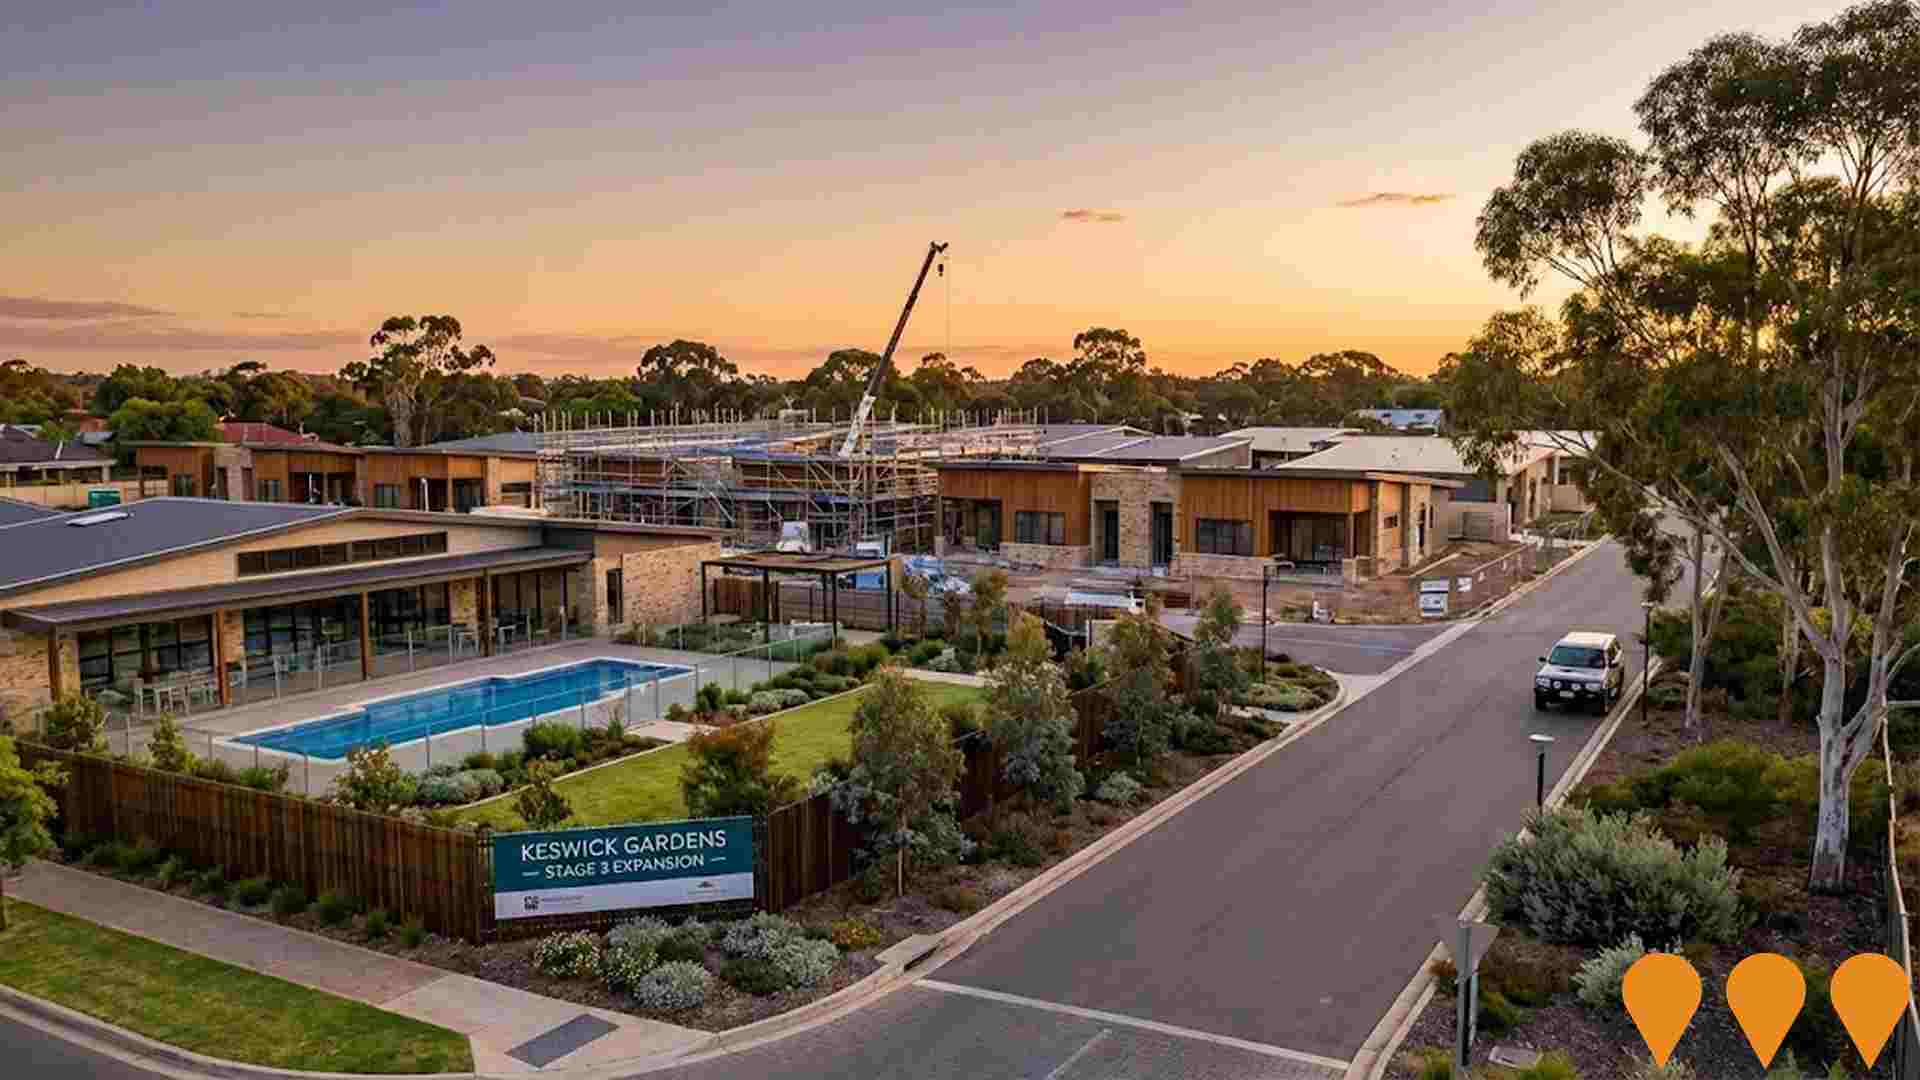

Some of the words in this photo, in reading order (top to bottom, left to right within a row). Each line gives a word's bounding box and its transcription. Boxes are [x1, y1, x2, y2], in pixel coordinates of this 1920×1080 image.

[521, 837, 618, 862] KESWICK
[623, 830, 727, 854] GARDENS
[545, 862, 596, 880] STAGE
[600, 861, 610, 875] 3
[613, 855, 705, 874] EXPANSION
